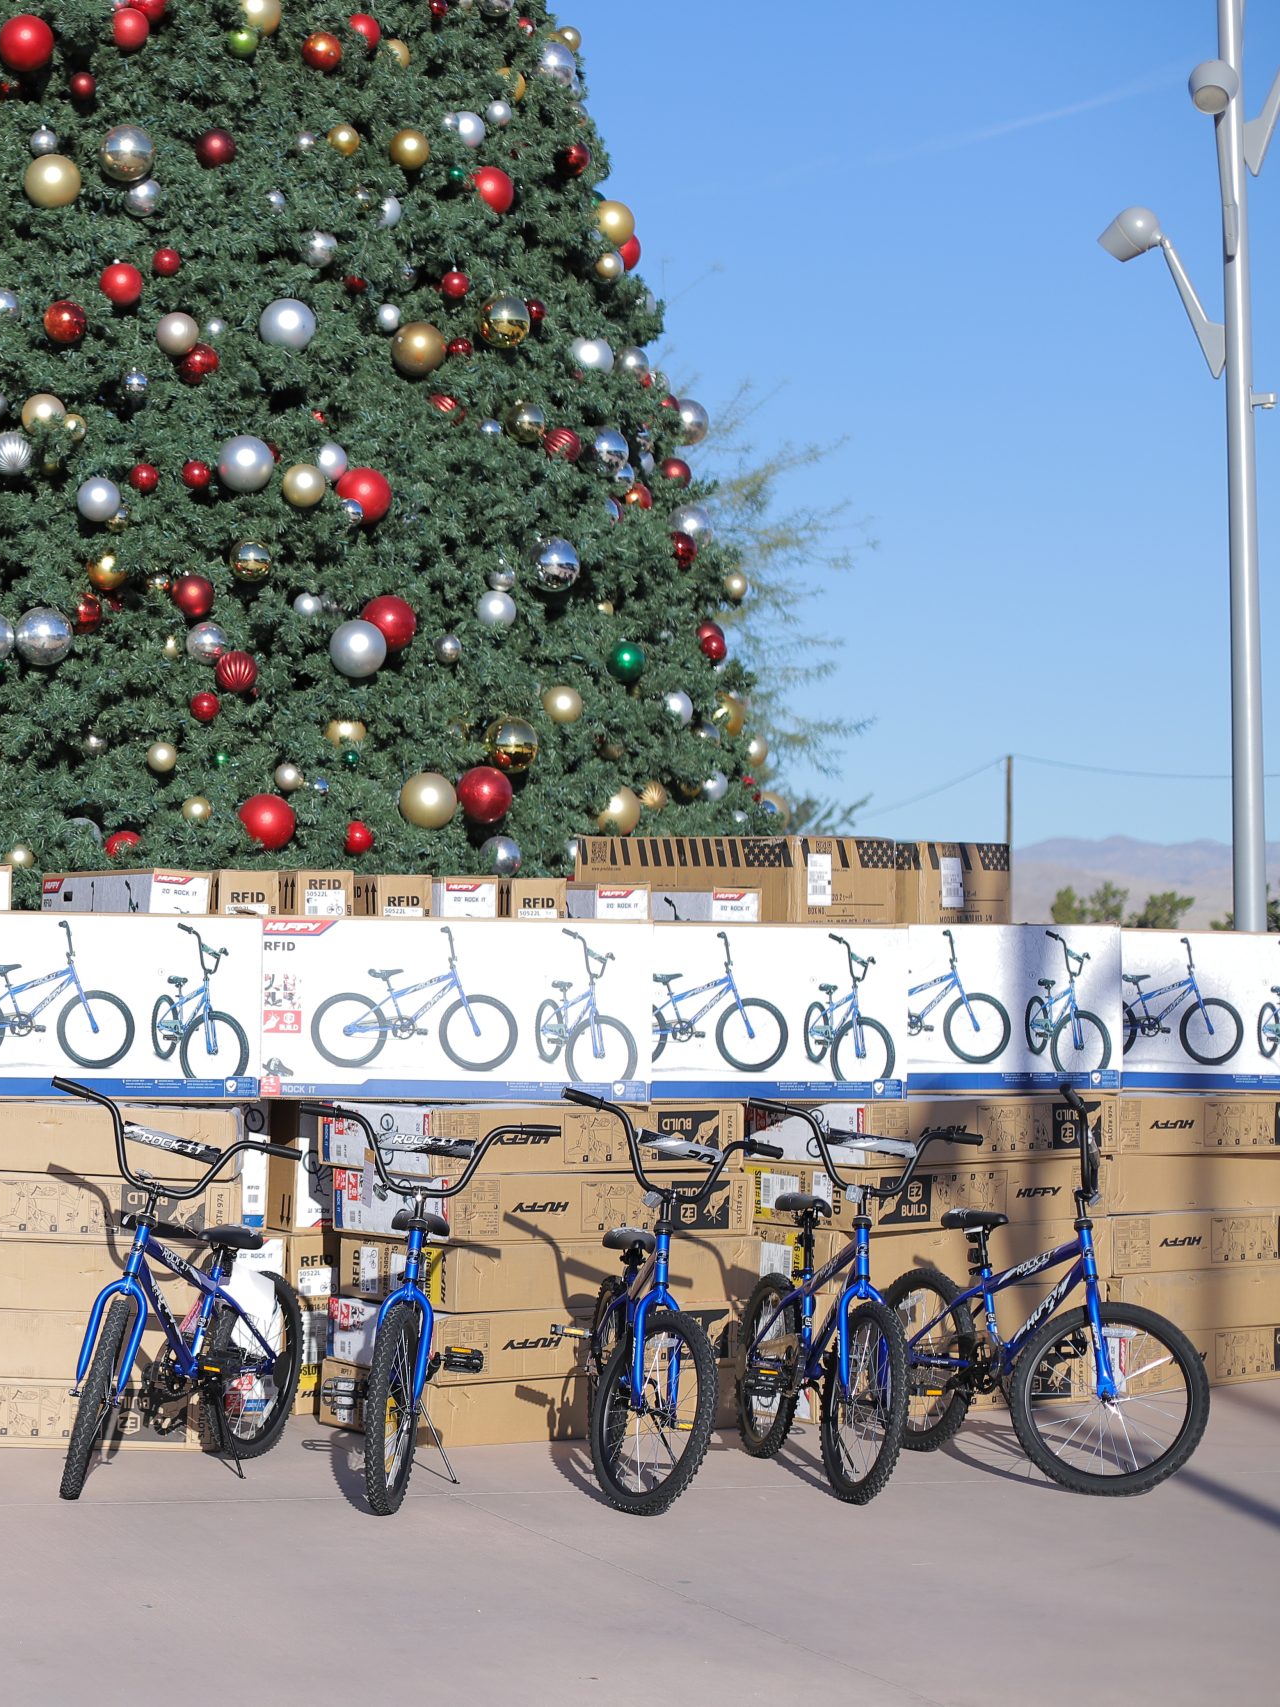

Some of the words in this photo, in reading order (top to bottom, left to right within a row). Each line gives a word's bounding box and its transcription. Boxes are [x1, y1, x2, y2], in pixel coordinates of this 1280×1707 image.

[157, 874, 187, 882] HUFFY
[308, 879, 341, 890] RFID
[230, 892, 265, 903] RFID
[387, 896, 420, 907] RFID
[522, 897, 556, 909] RFID
[264, 922, 322, 932] HUFFY
[263, 941, 296, 951] RFID
[282, 1085, 305, 1093] ROCK
[662, 1117, 692, 1131] BUILD
[1149, 1120, 1195, 1130] HUFFY
[1062, 1128, 1074, 1138] EZ
[908, 1184, 922, 1194] EZ
[1016, 1186, 1062, 1198] HUFFY
[511, 1202, 570, 1213] HUFFY
[682, 1207, 696, 1218] EZ
[901, 1203, 927, 1217] BUILD
[1159, 1236, 1203, 1248] HUFFY
[300, 1255, 334, 1268] RFID
[1016, 1258, 1040, 1276] ROCK
[352, 1249, 361, 1288] RFID
[502, 1336, 563, 1351] HUFFY
